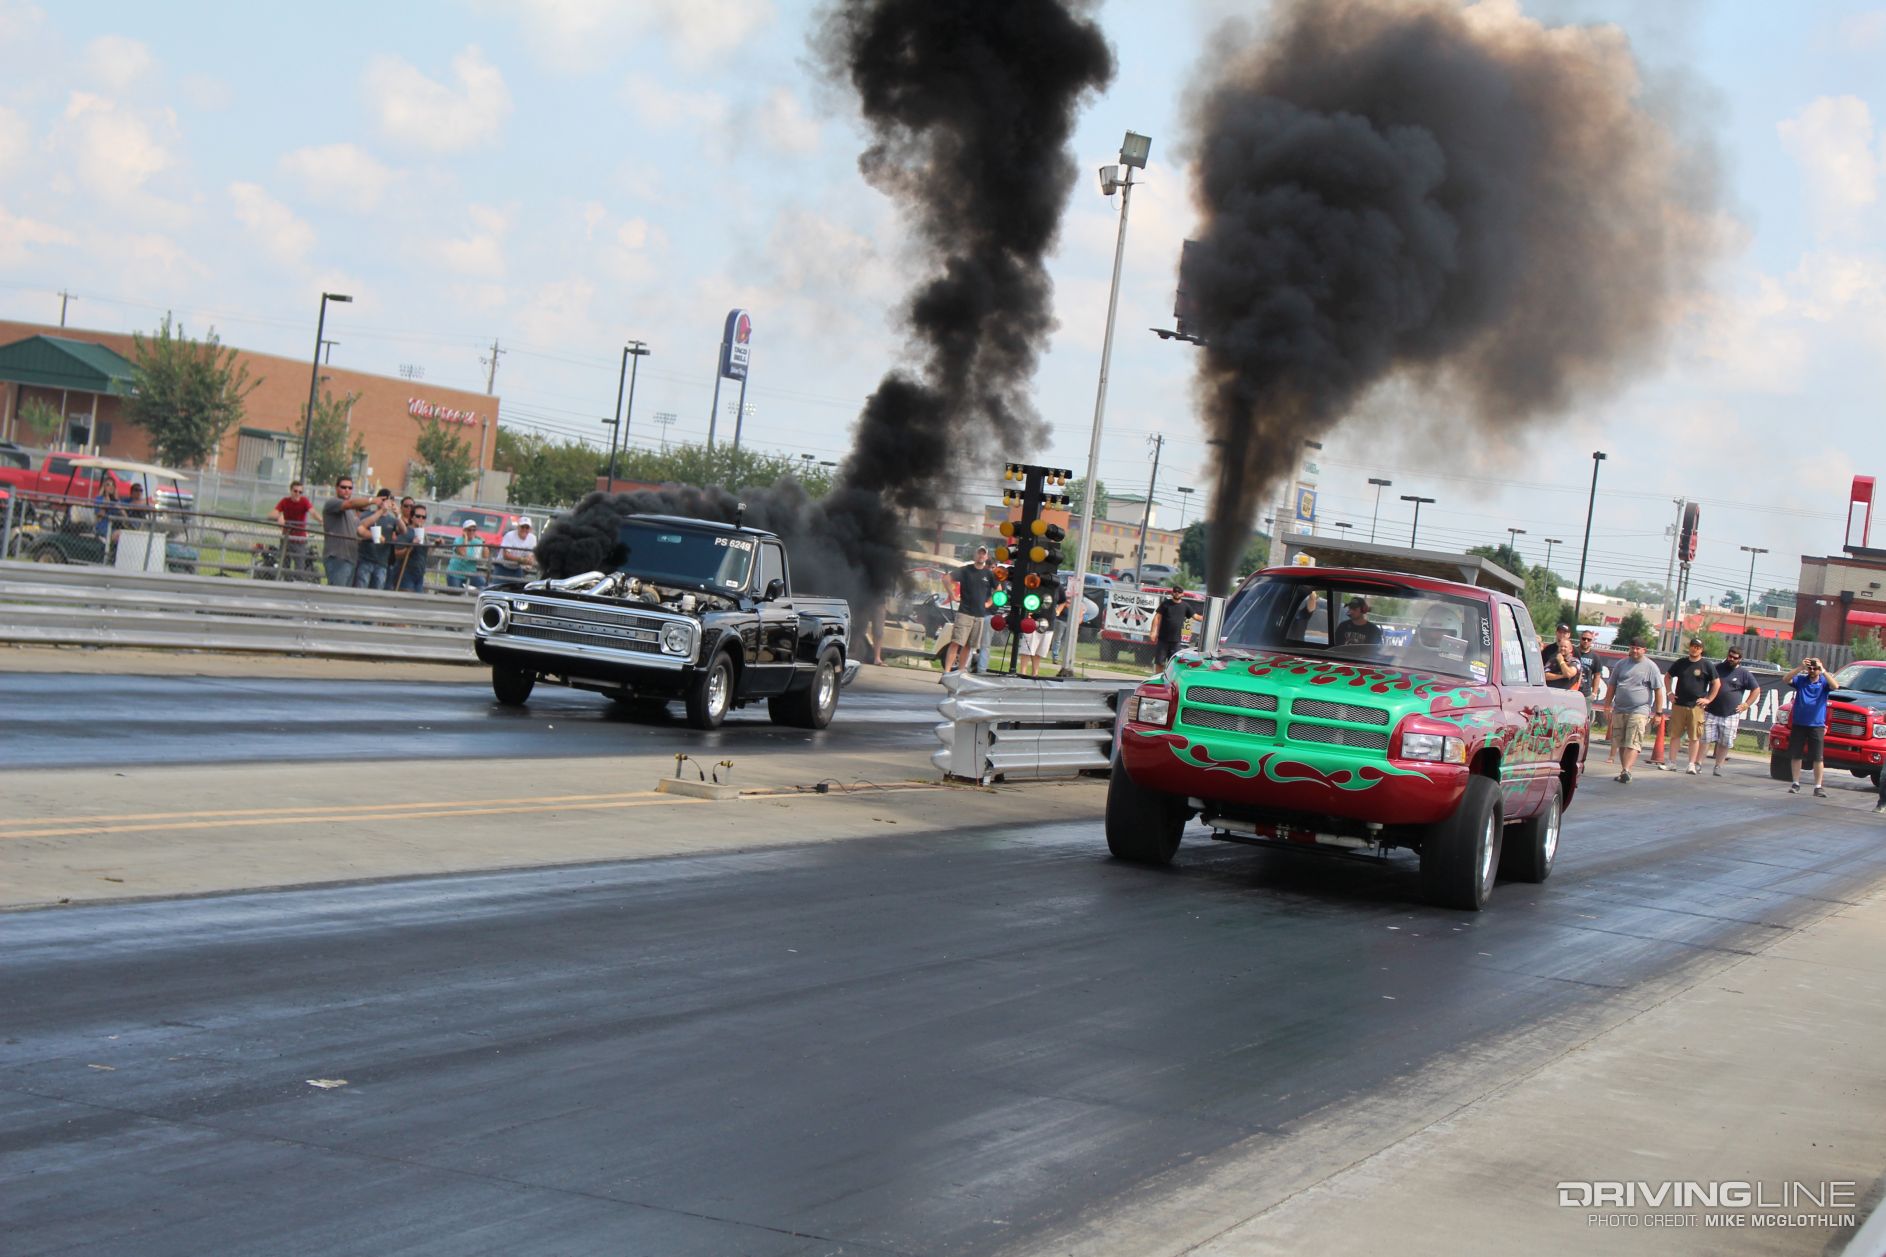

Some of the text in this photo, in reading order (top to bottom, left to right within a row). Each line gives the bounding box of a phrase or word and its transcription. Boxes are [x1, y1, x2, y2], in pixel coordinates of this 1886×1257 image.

[734, 346, 748, 355] TACO
[733, 353, 747, 363] BELL
[714, 537, 752, 552] PS 6249
[1113, 593, 1155, 606] Scheid Diesel
[534, 618, 632, 637] CHEVROLET
